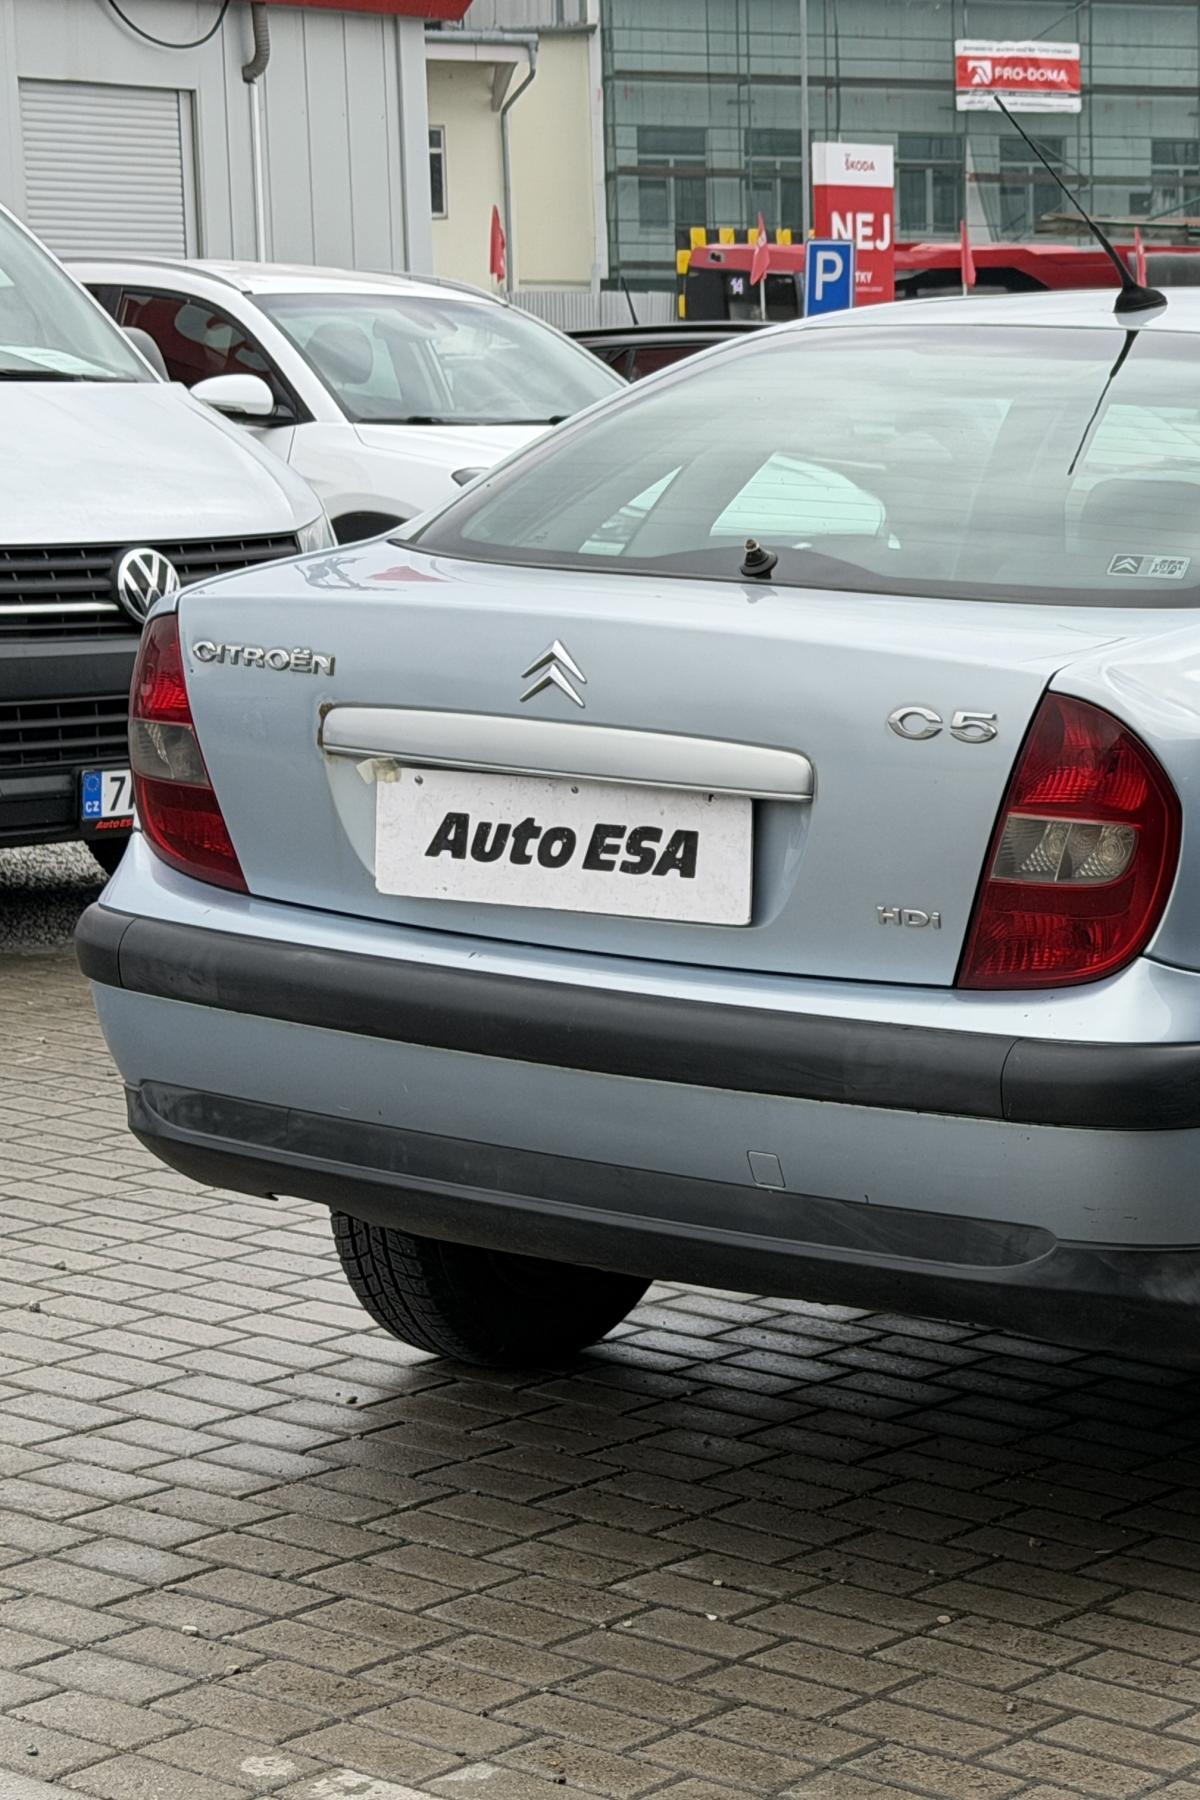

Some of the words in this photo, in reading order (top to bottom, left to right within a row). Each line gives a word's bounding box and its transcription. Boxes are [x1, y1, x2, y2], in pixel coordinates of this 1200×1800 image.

[994, 65, 1069, 83] PRO-DOMA
[845, 156, 876, 172] ŠKODA
[831, 211, 891, 251] NEJ
[815, 251, 844, 301] P
[192, 640, 336, 677] CITROËN
[887, 706, 999, 744] C5
[85, 800, 100, 814] CZ
[424, 811, 577, 869] Auto
[581, 822, 700, 879] ESA
[876, 904, 943, 930] HDi
